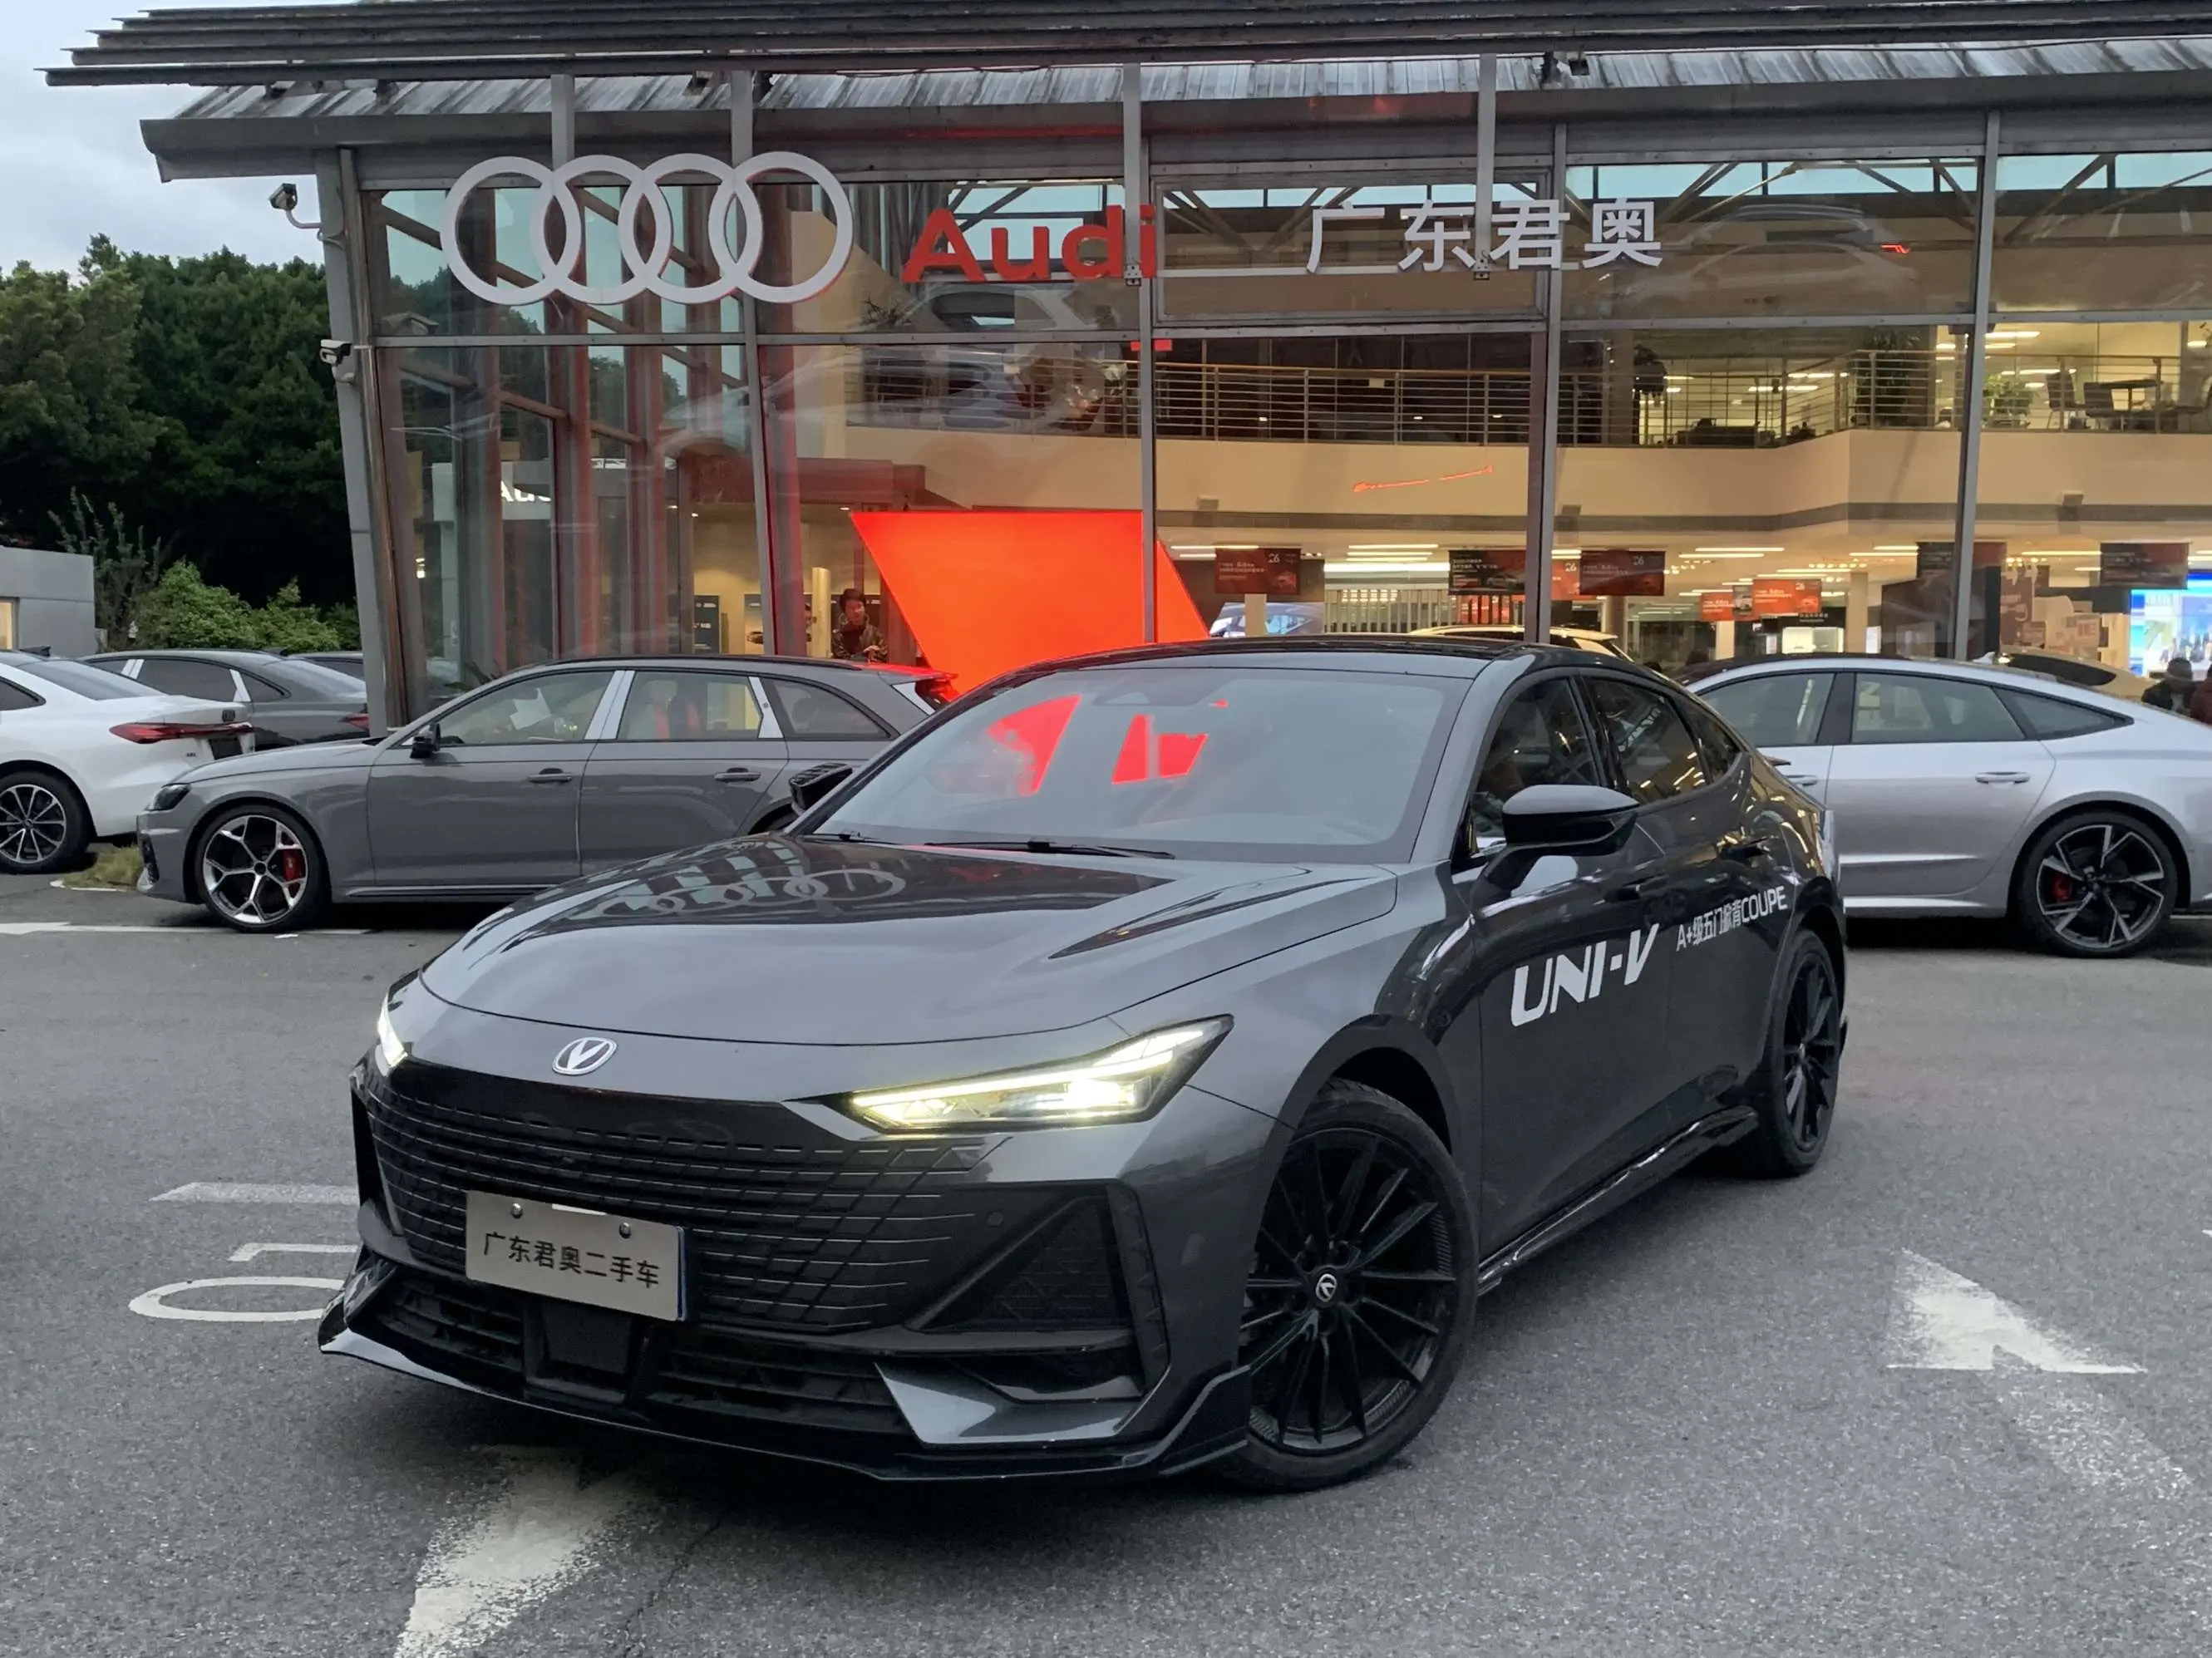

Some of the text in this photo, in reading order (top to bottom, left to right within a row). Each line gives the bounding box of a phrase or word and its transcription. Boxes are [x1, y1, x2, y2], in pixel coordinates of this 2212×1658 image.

[901, 204, 1157, 283] Audi
[1306, 198, 1663, 274] 广东君奥
[1510, 923, 1660, 1027] UNI-V
[483, 1231, 660, 1288] 广东君奥二手车
